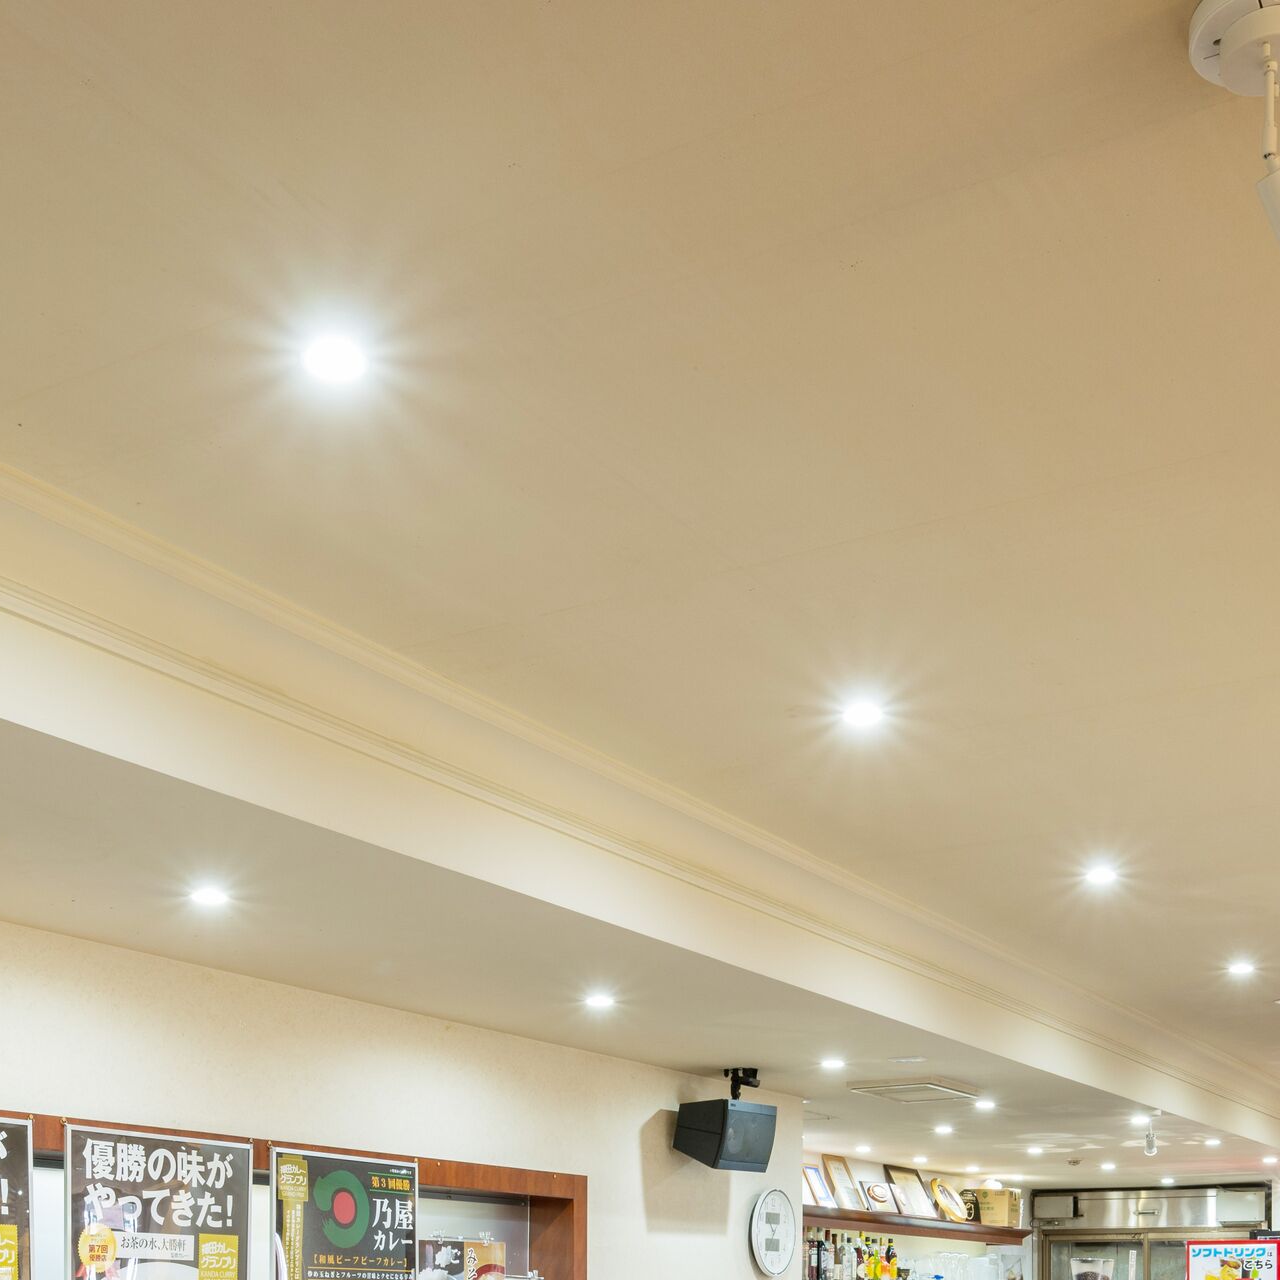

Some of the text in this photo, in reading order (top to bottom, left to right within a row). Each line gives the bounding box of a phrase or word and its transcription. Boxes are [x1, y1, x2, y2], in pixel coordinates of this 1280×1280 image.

[82, 1138, 234, 1189] 優勝の味が
[372, 1197, 414, 1230] 乃屋
[373, 1229, 414, 1251] カレー
[1244, 1259, 1273, 1270] こちら
